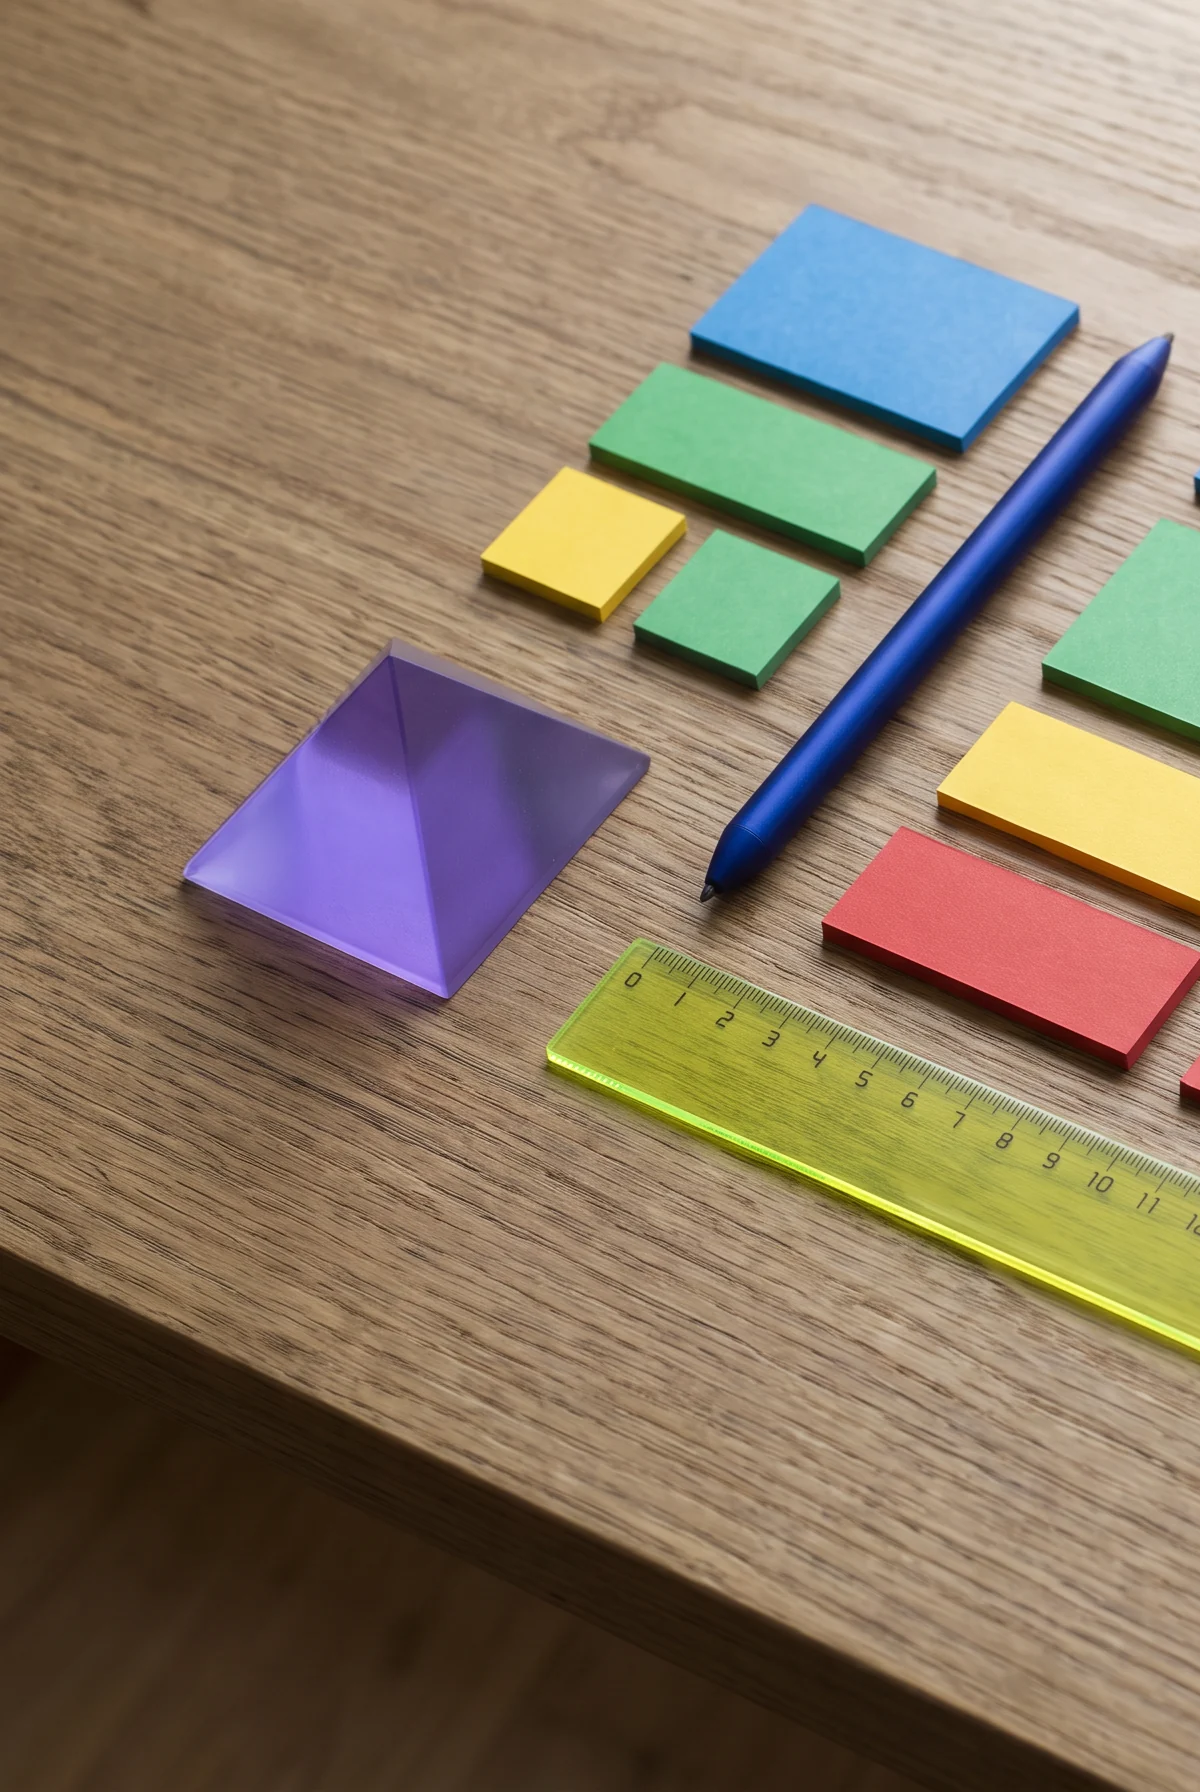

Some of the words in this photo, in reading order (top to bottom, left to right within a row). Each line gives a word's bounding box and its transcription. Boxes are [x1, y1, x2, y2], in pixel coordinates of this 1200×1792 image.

[624, 972, 642, 988] 0
[674, 992, 686, 1006] 1
[715, 1011, 734, 1028] 2
[762, 1030, 780, 1047] 3
[812, 1051, 827, 1068] 4
[855, 1071, 873, 1088] 5
[901, 1091, 918, 1108] 6
[951, 1111, 966, 1128] 7
[995, 1132, 1013, 1149] 8
[1042, 1152, 1061, 1169] 9
[1087, 1172, 1114, 1193] 10
[1136, 1193, 1161, 1214] 11
